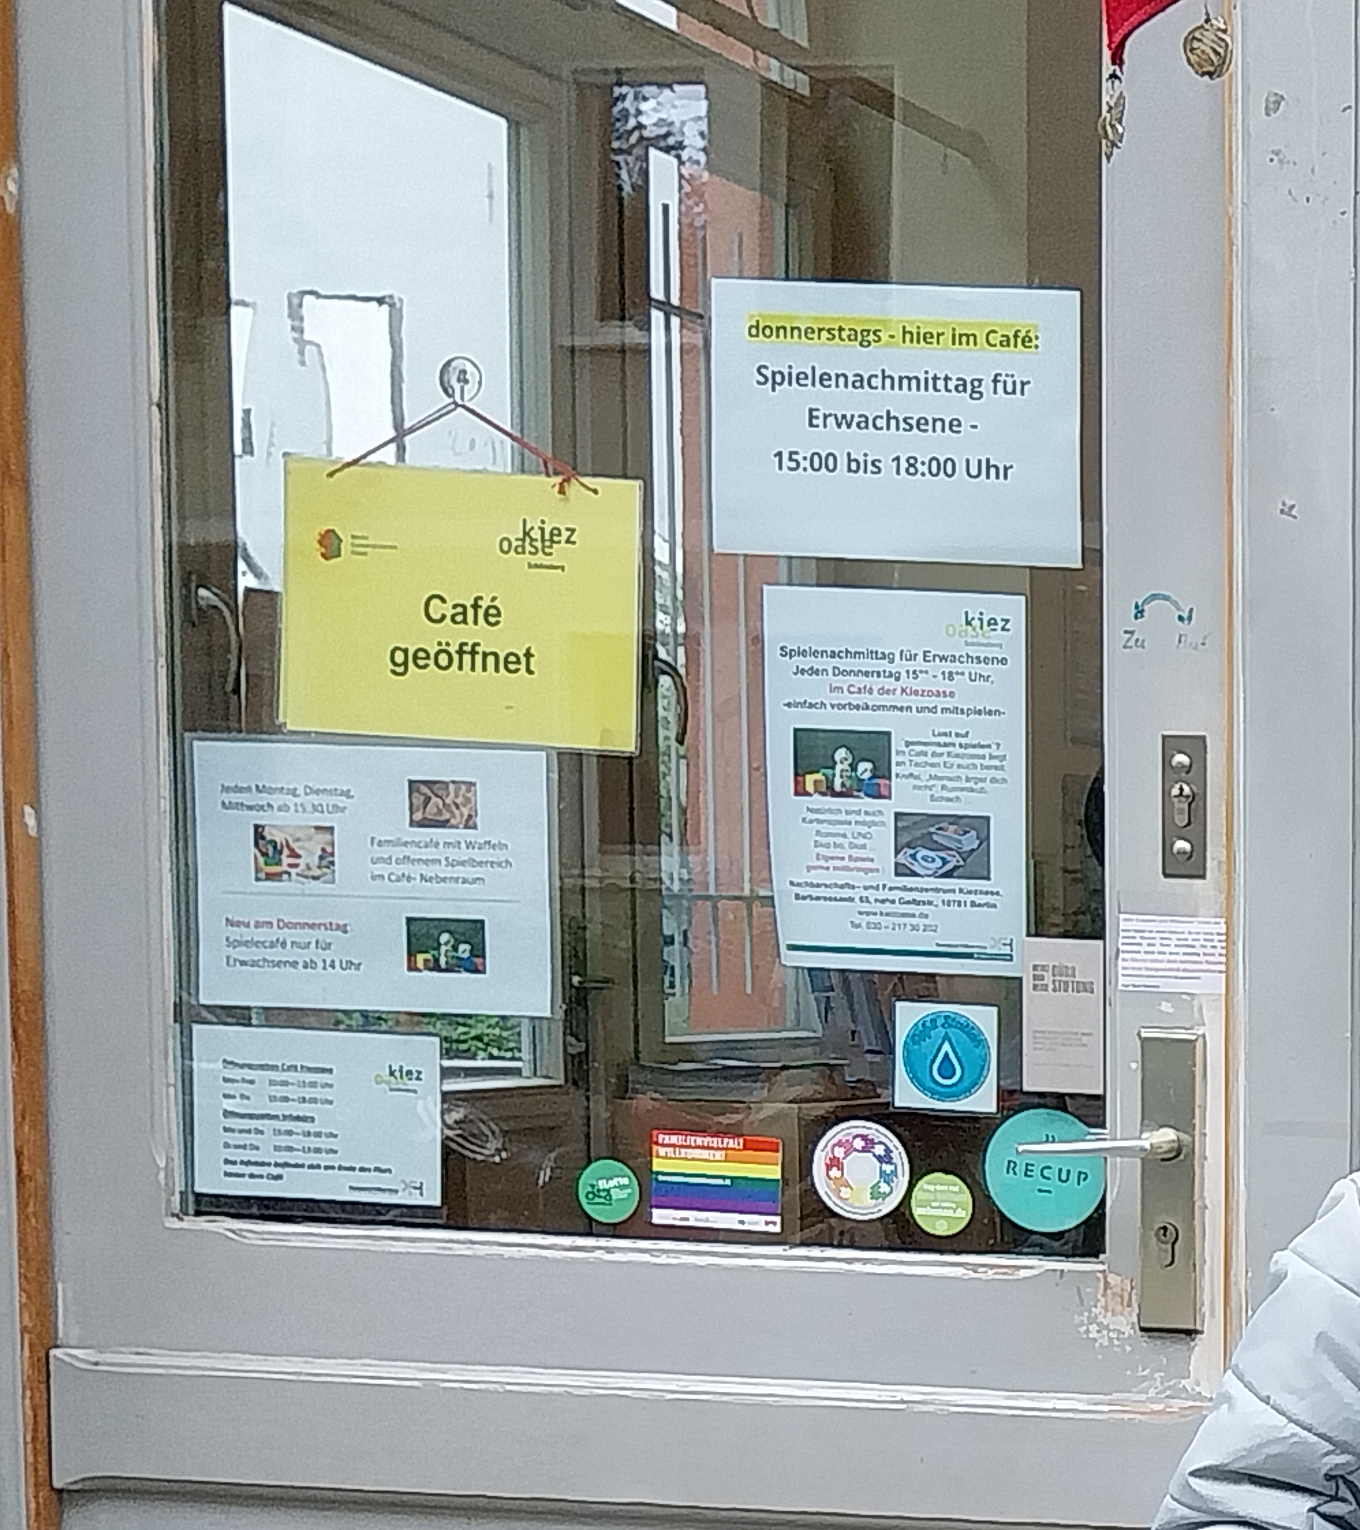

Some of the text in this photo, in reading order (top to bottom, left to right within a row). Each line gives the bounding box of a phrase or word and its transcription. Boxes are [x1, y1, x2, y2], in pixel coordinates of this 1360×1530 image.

[747, 320, 882, 349] donnerstags
[901, 324, 944, 346] hier
[951, 327, 978, 347] im
[985, 328, 1040, 350] Café:
[755, 364, 1031, 400] Spielenachmittag für
[807, 407, 962, 434] Erwachsene
[774, 450, 1014, 481] 15:00 bis 18:00 Uhr
[523, 518, 576, 546] kiez
[499, 536, 553, 556] oase
[424, 593, 502, 627] Café
[964, 611, 1011, 632] kiez
[1122, 630, 1145, 649] Zu
[389, 641, 535, 676] geöffnet
[779, 646, 1008, 666] Spielenachmittag für Erwachsene
[792, 666, 828, 677] Jeden
[832, 666, 901, 682] Donnerstag
[847, 684, 873, 695] Café
[878, 686, 896, 696] der
[900, 686, 956, 698] Kiezoase
[830, 701, 912, 714] vorbeikommen
[916, 705, 937, 715] und
[225, 917, 249, 928] Neu
[254, 920, 273, 929] am
[291, 940, 311, 949] nur
[316, 938, 332, 950] für
[302, 958, 317, 969] ab
[322, 959, 336, 970] 14
[339, 959, 362, 971] Uhr
[1005, 1160, 1090, 1187] RECUP
